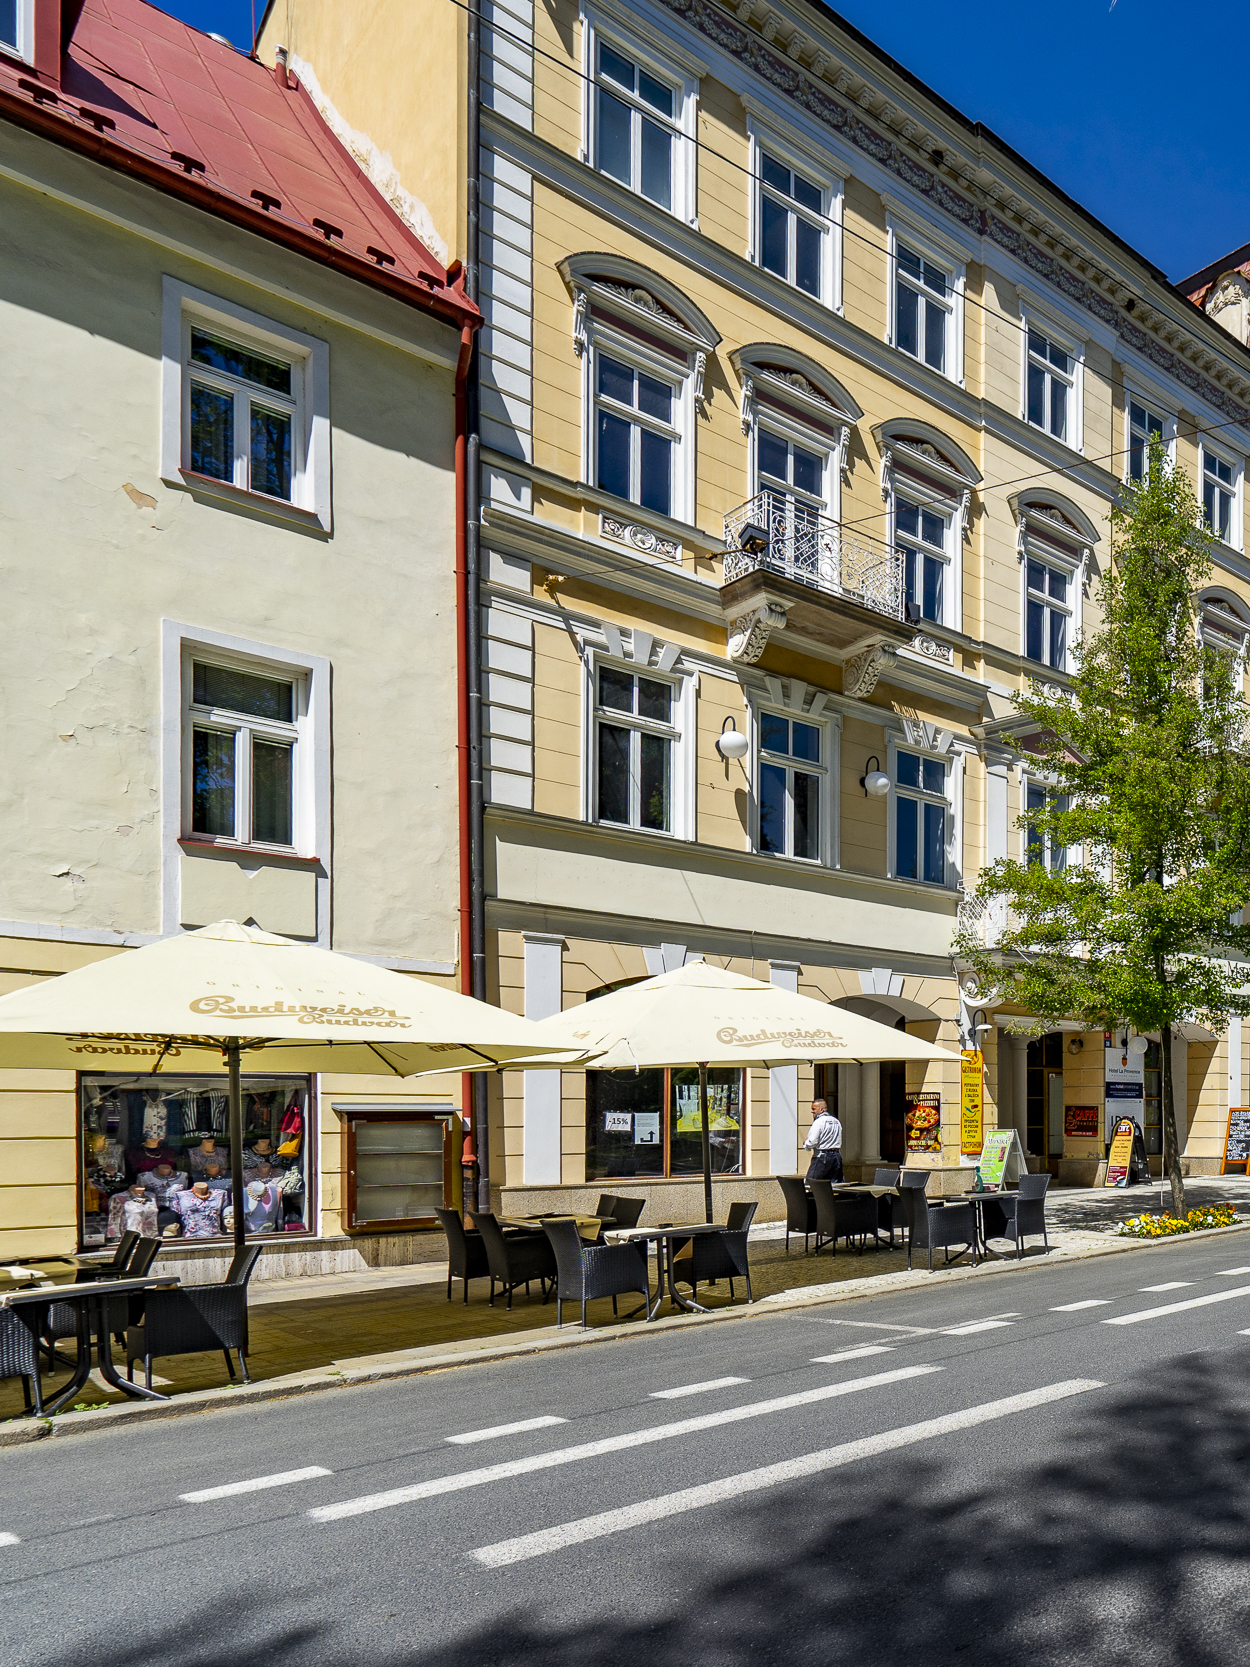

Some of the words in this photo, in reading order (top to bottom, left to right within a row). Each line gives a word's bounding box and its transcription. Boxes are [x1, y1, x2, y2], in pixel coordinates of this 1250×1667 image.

[206, 981, 366, 996] ORIGINAL
[189, 995, 411, 1020] Budweiser
[297, 1012, 412, 1028] Budvar
[716, 1026, 843, 1047] Budweiser
[782, 1038, 848, 1049] Budvar
[608, 1117, 629, 1125] -15%
[1074, 1108, 1097, 1120] CAFFÉ
